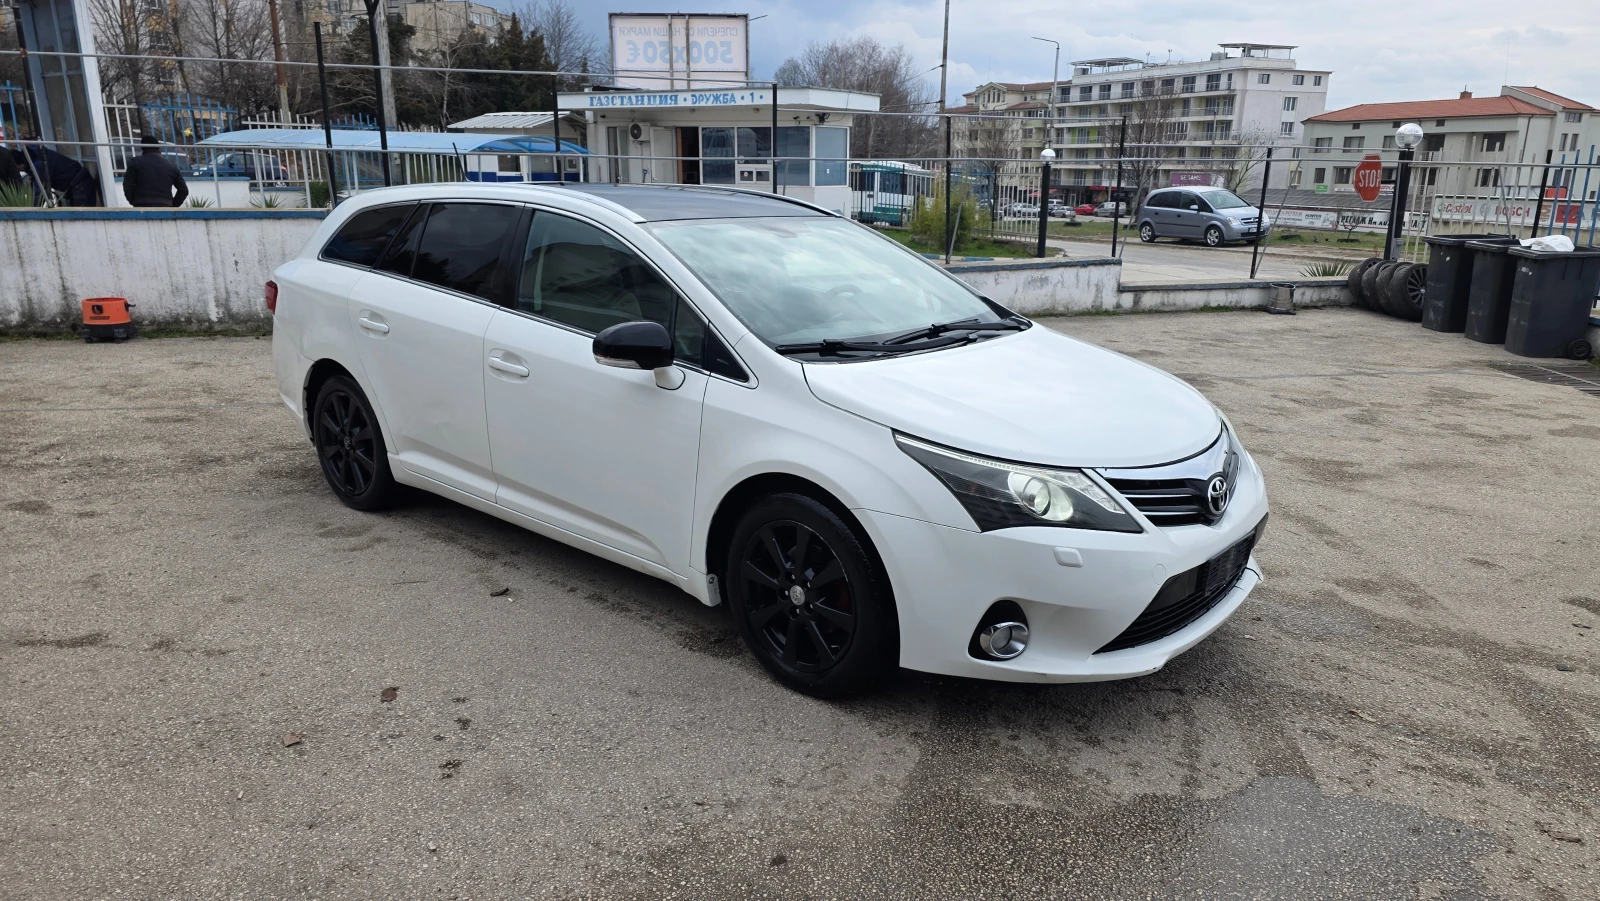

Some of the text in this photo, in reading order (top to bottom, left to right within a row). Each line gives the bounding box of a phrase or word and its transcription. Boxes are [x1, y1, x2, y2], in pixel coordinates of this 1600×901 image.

[589, 92, 755, 107] ГАЗСТАНЦИЯ ДРУЖБА 1
[1359, 169, 1381, 188] STOP
[1445, 203, 1473, 214] Cstol
[1495, 205, 1531, 217] BOSCH
